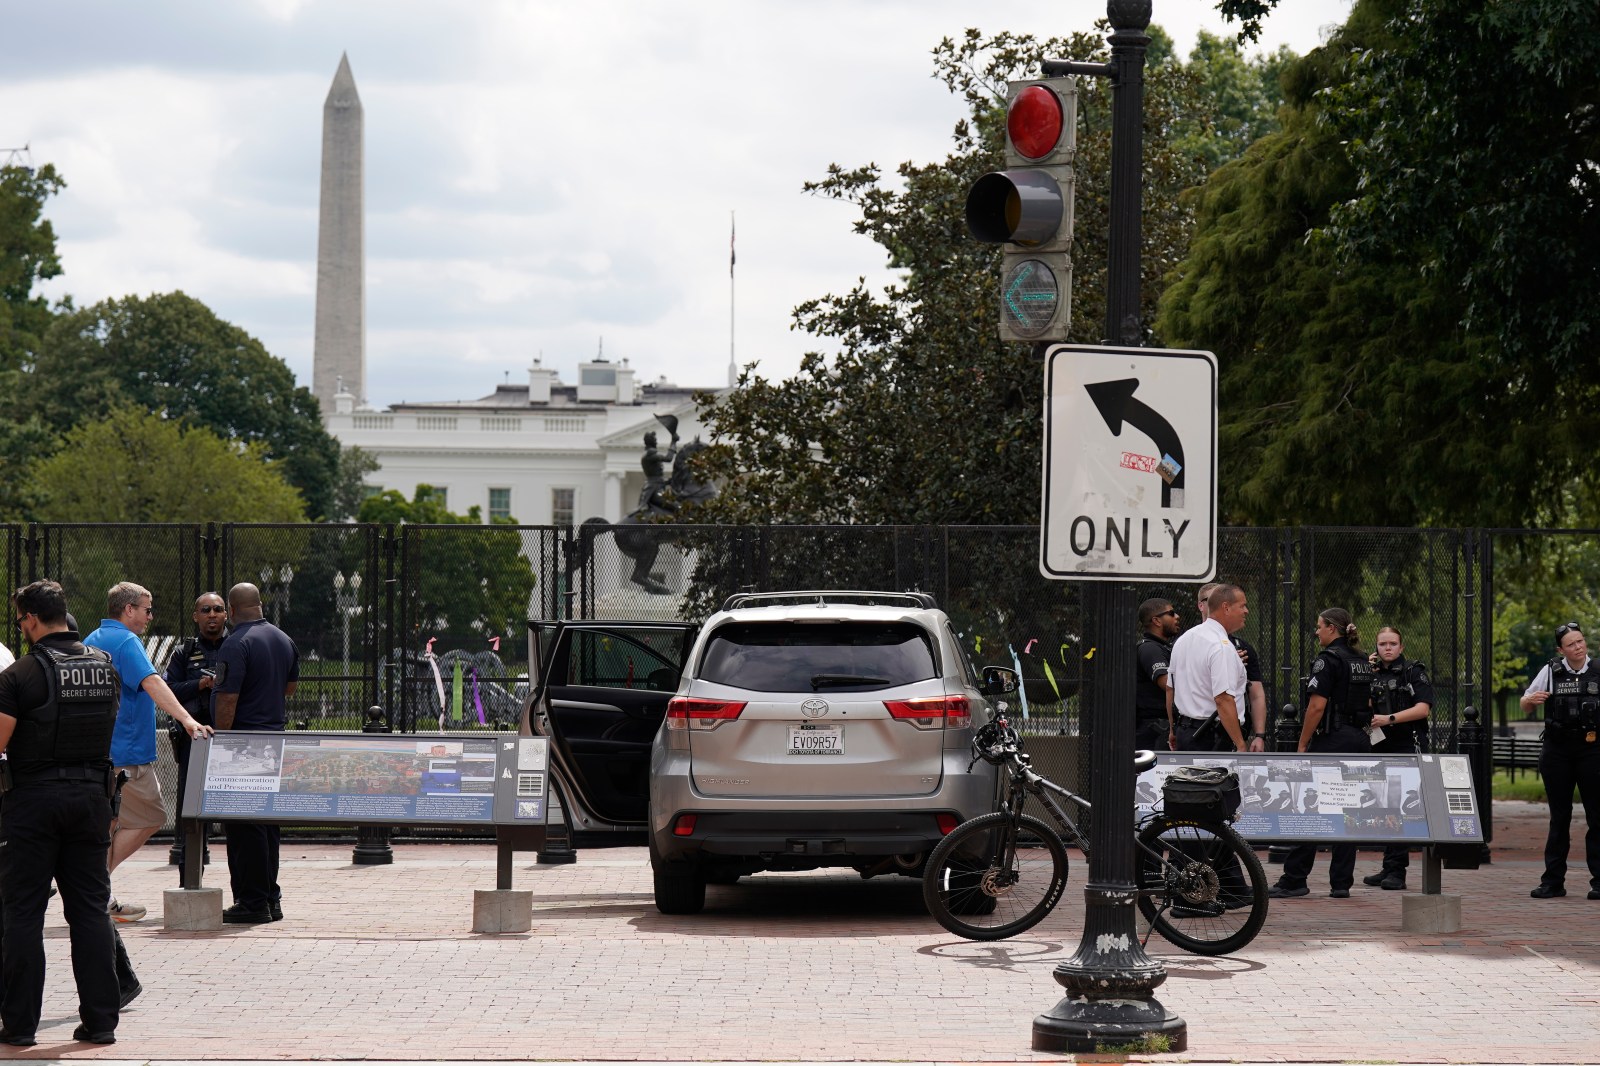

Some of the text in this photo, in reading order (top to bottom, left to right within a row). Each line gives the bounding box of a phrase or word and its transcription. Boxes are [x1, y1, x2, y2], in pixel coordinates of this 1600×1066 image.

[1070, 515, 1191, 558] ONLY
[60, 668, 112, 686] POLICE
[61, 688, 113, 698] SECRET SERVICE
[793, 736, 837, 749] EV09R57
